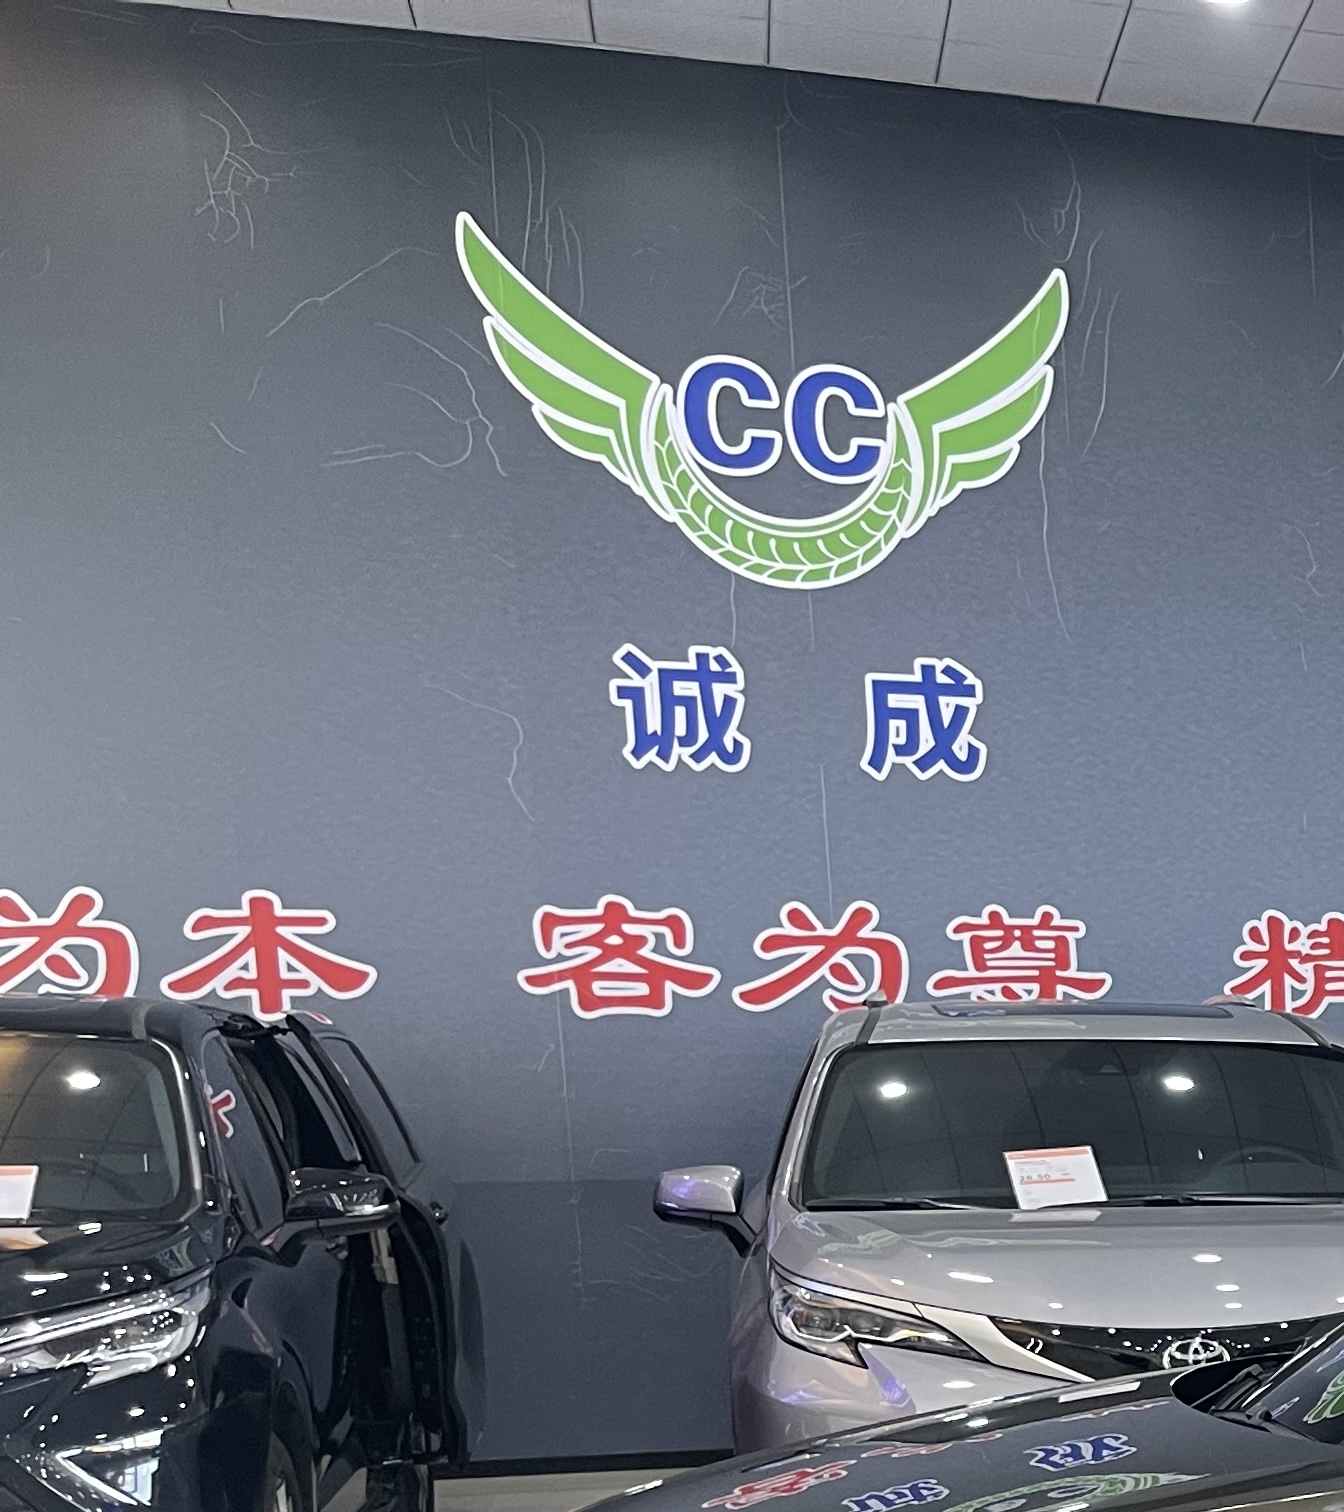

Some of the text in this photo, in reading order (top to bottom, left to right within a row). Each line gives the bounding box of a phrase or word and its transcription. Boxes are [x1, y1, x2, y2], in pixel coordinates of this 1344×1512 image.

[675, 354, 886, 484] CC
[0, 886, 378, 1022] 为本
[517, 894, 1112, 1018] 客为尊
